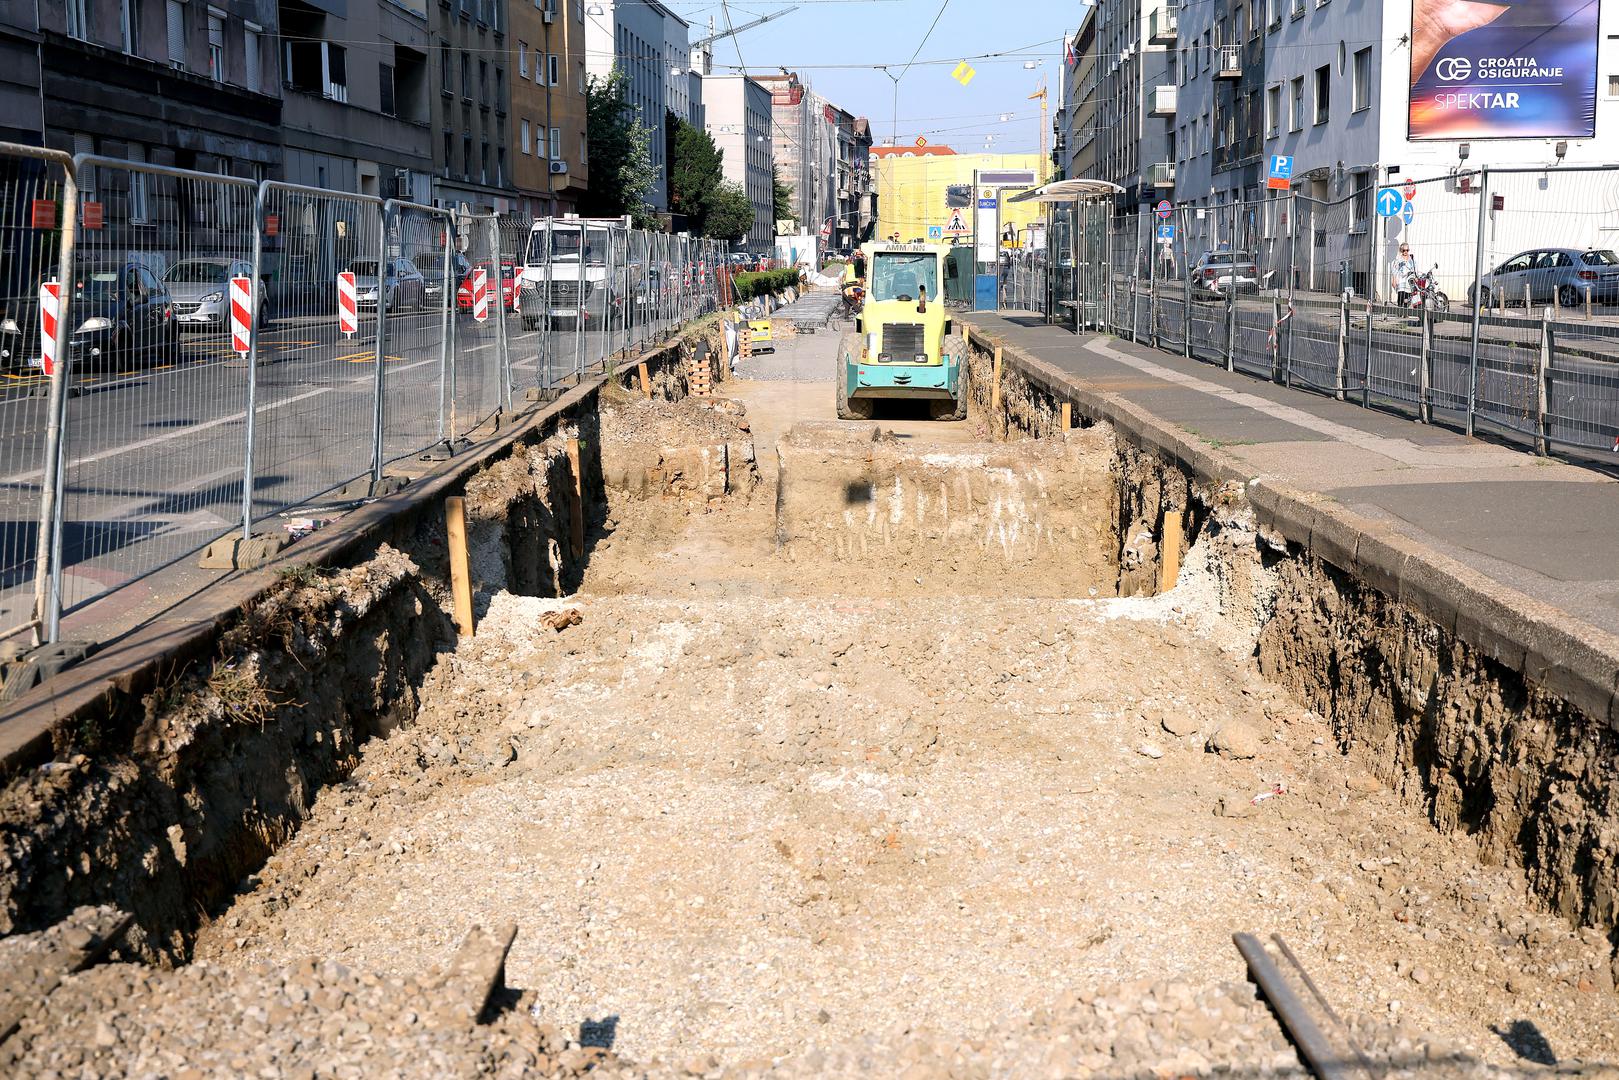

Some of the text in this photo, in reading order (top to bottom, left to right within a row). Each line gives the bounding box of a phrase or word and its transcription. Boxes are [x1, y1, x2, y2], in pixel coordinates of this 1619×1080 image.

[1478, 58, 1537, 68] CROATIA
[1478, 68, 1563, 78] OSIGURANJE
[1435, 93, 1519, 109] SPEKTAR
[1275, 156, 1287, 172] P
